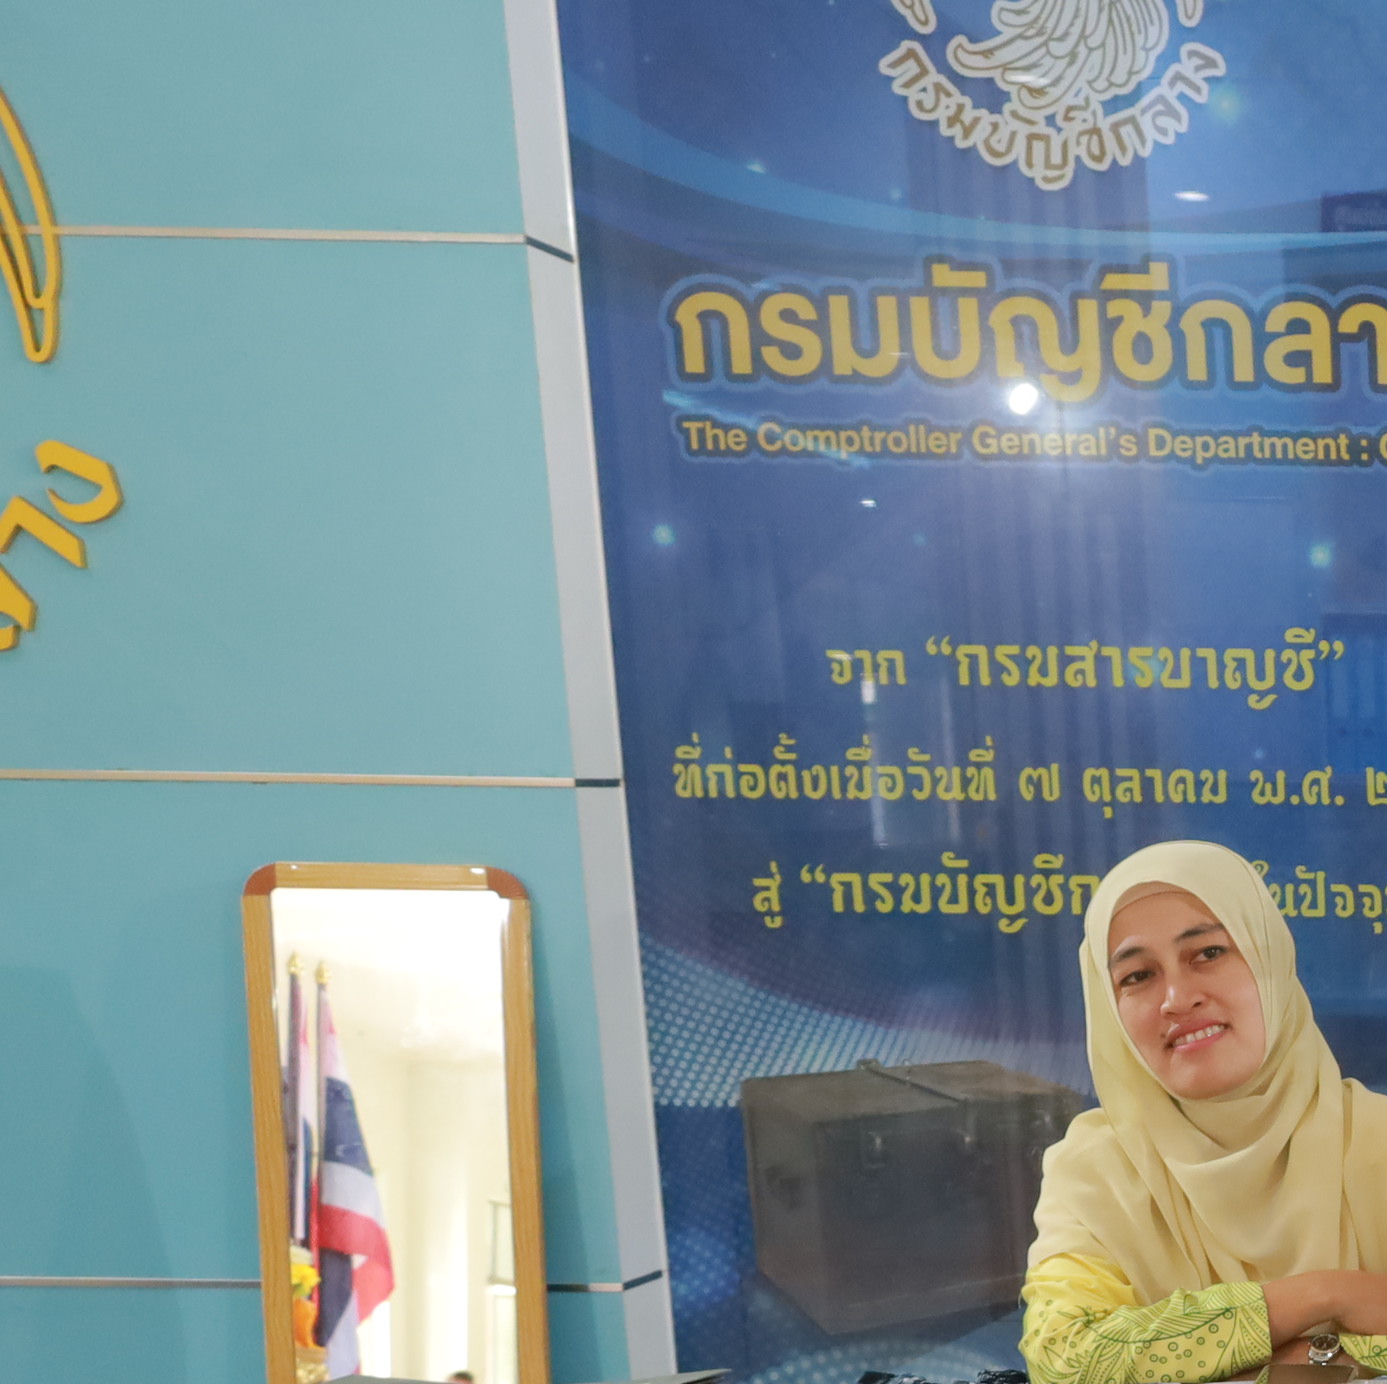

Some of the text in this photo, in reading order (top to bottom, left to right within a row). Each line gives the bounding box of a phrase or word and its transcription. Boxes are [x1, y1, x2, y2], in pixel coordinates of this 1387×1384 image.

[885, 46, 1220, 185] กรมบัญชีกลาง
[682, 421, 748, 451] The
[757, 422, 963, 459] Comptroller
[1148, 428, 1350, 464] Department
[825, 649, 907, 684] จาก
[1019, 763, 1060, 800] ๗
[1083, 767, 1227, 818] ตุลาคม
[1250, 766, 1344, 805] พ.ศ.
[753, 861, 783, 928] สู่
[800, 852, 1101, 933] “กรมบัญชีก
